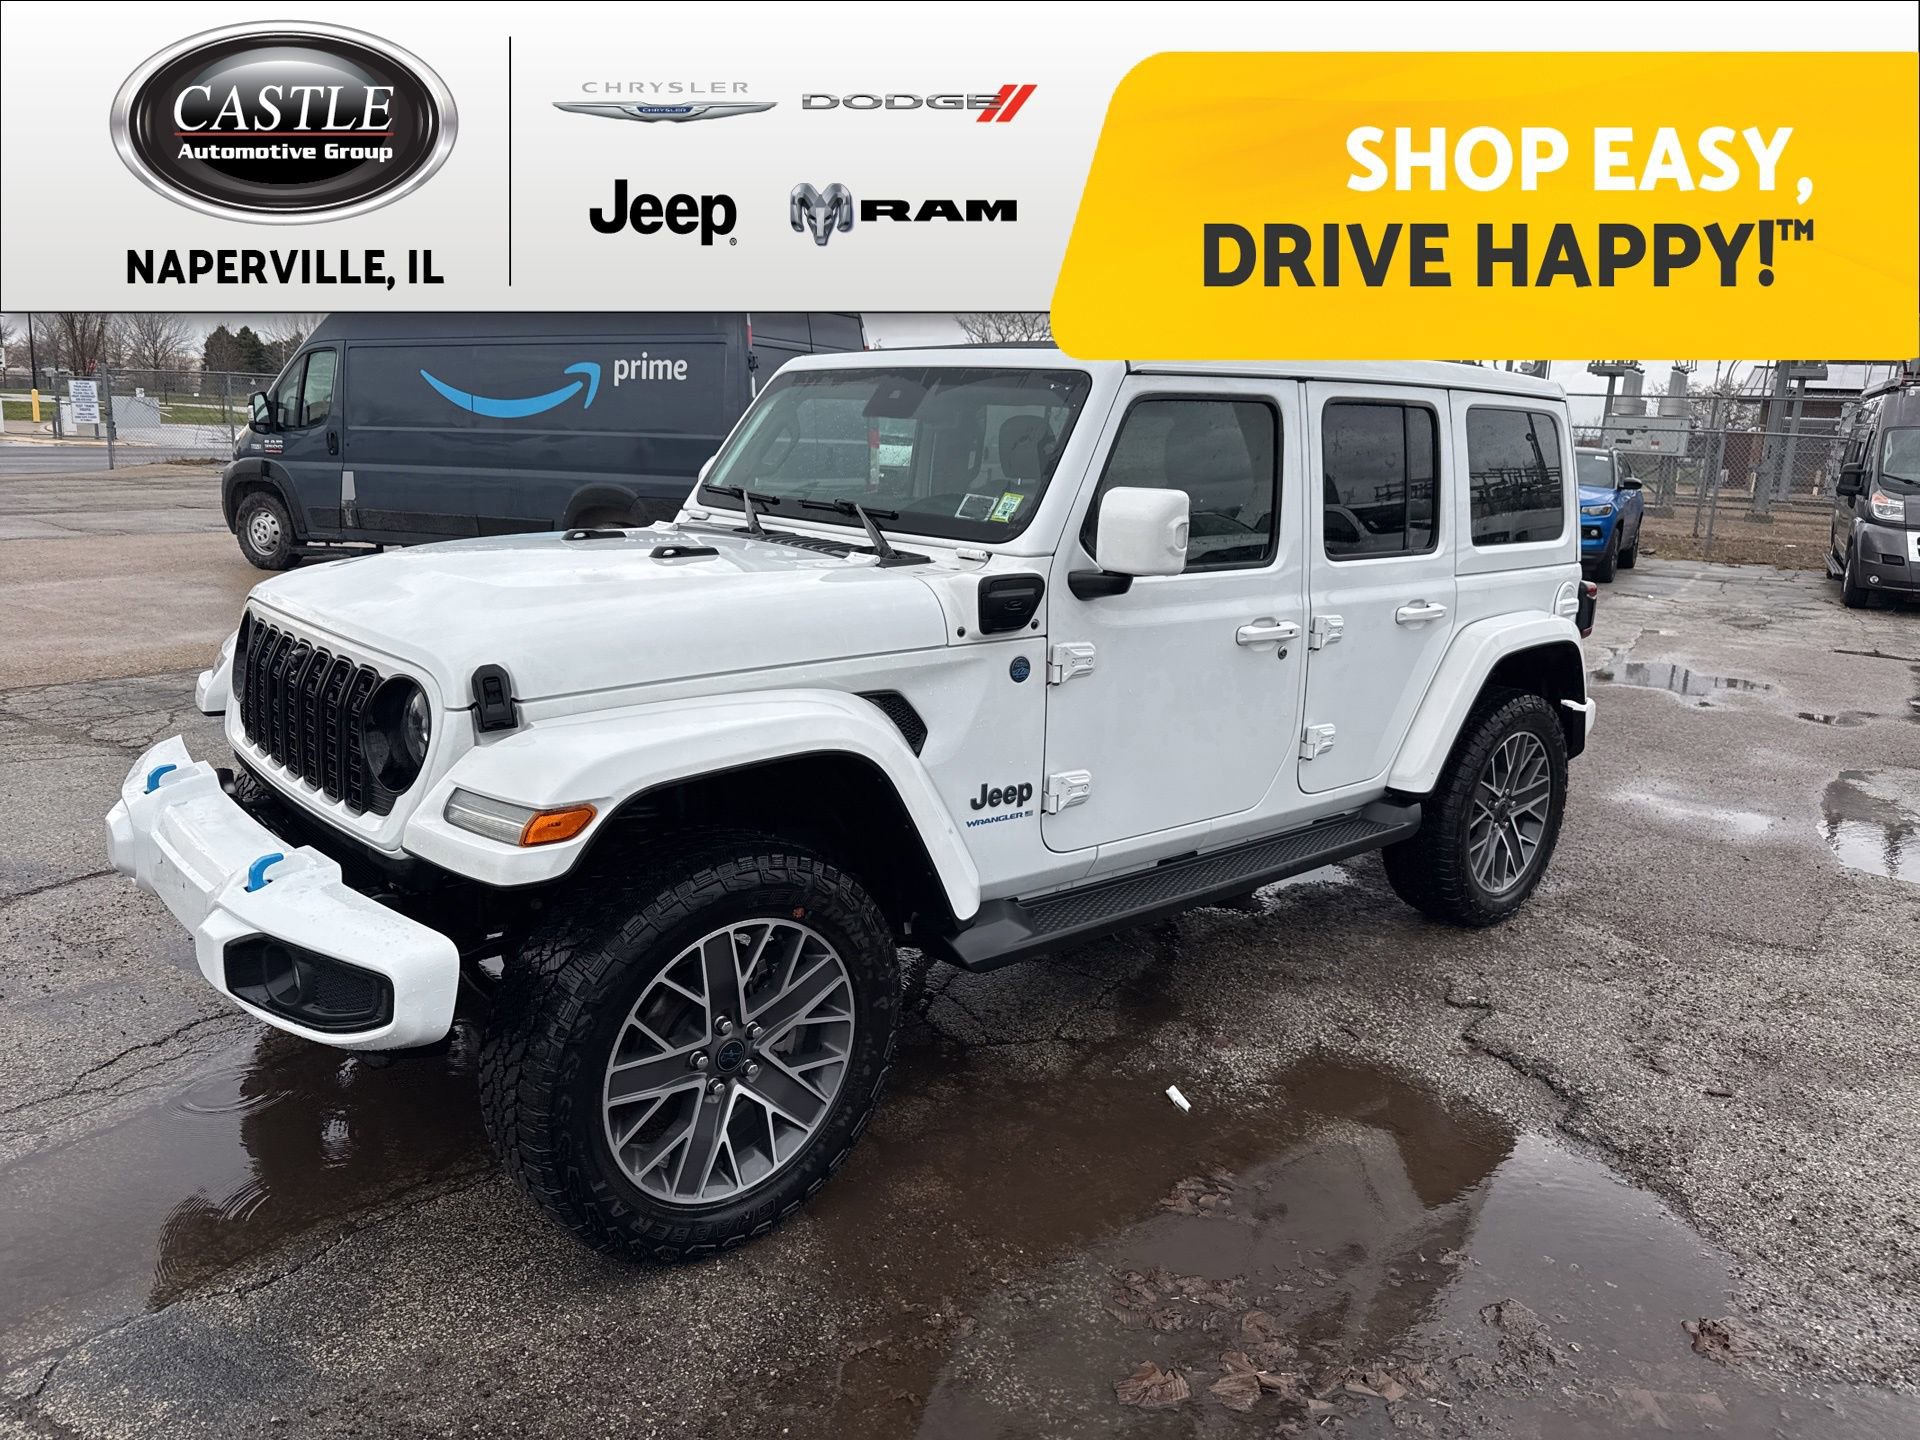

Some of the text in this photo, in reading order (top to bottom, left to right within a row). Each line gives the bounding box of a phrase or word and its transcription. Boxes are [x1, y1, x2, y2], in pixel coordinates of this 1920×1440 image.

[613, 351, 688, 387] prime
[970, 782, 1033, 811] Jeep
[966, 812, 1023, 828] WRANGLER
